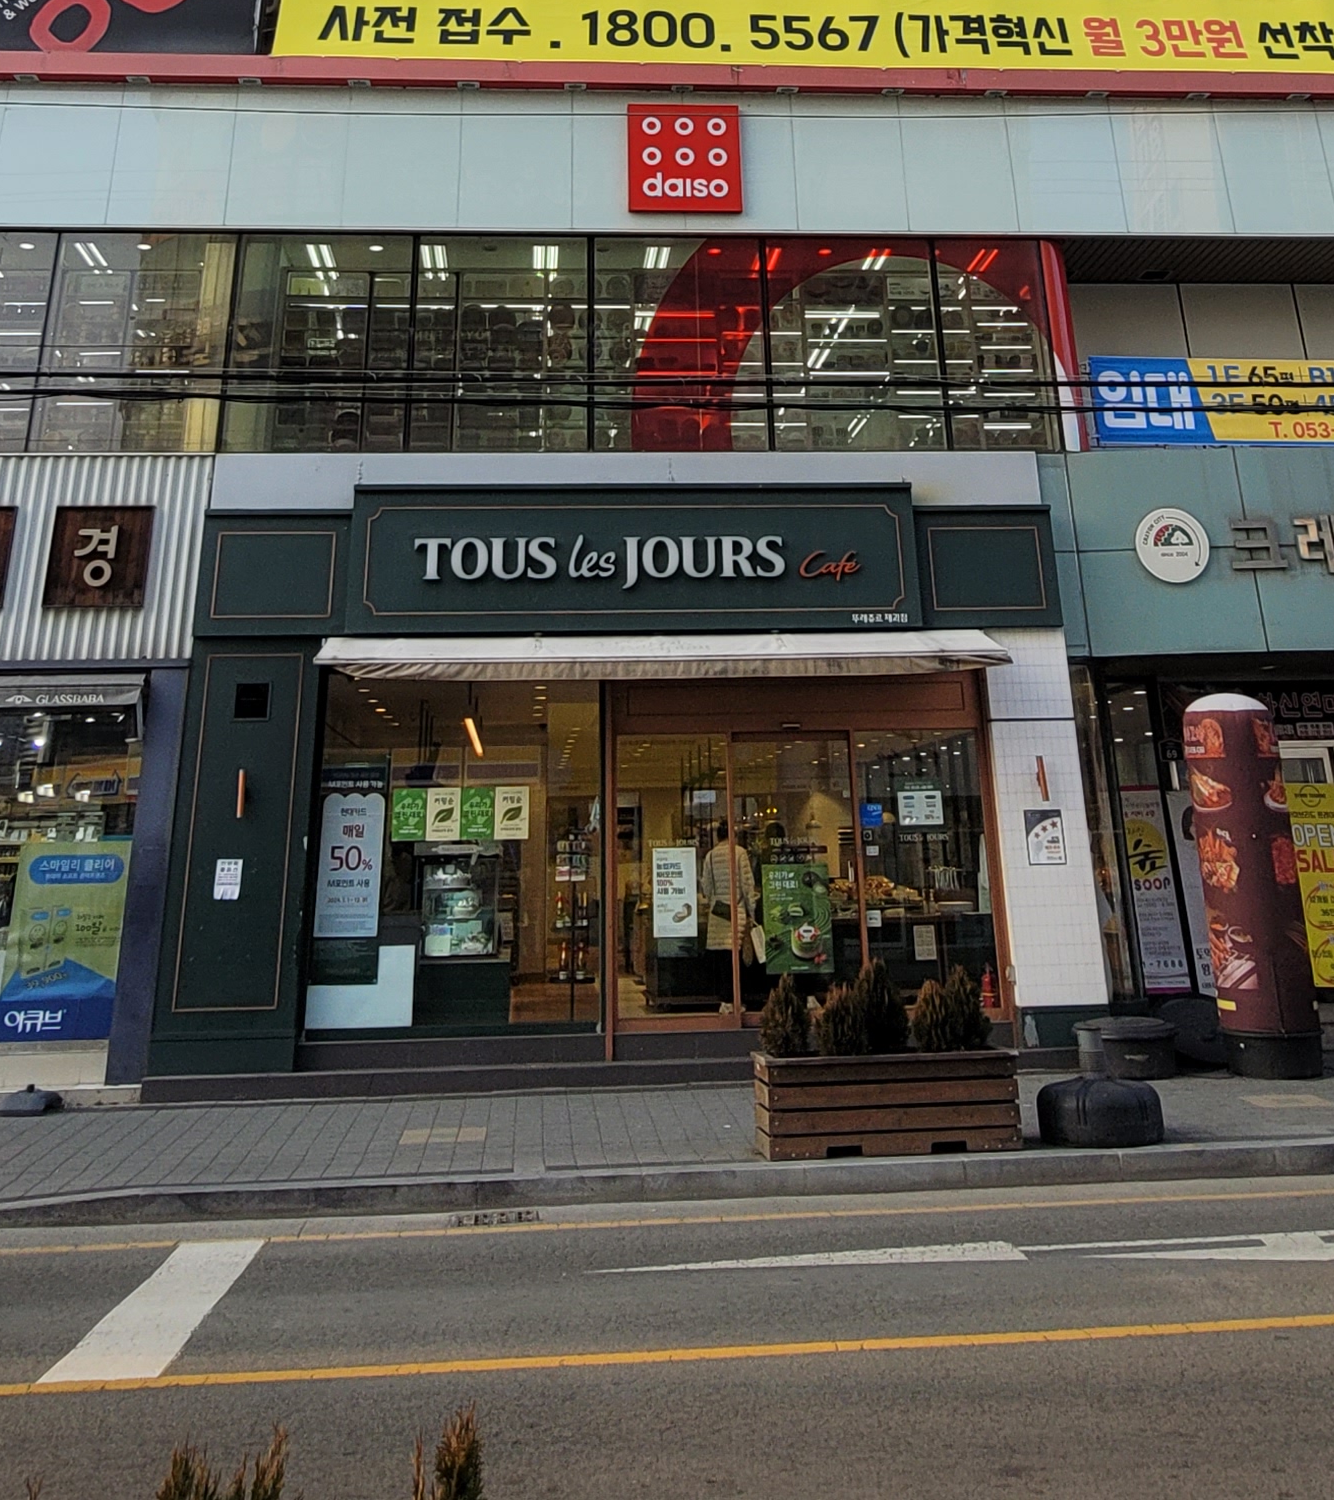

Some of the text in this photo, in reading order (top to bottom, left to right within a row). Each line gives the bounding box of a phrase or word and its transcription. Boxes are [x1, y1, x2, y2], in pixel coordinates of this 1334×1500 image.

[317, 6, 417, 45] 사전
[436, 6, 531, 45] 접수
[1083, 17, 1127, 59] 월
[1135, 18, 1249, 61] 3만원
[642, 172, 729, 198] daiso
[1097, 370, 1197, 430] 임대
[414, 534, 786, 590] TOUS les JOURS
[35, 693, 105, 706] GLASSBABA
[342, 824, 365, 838] 매일
[329, 845, 373, 872] 50%
[4, 1009, 67, 1033] 아큐브
